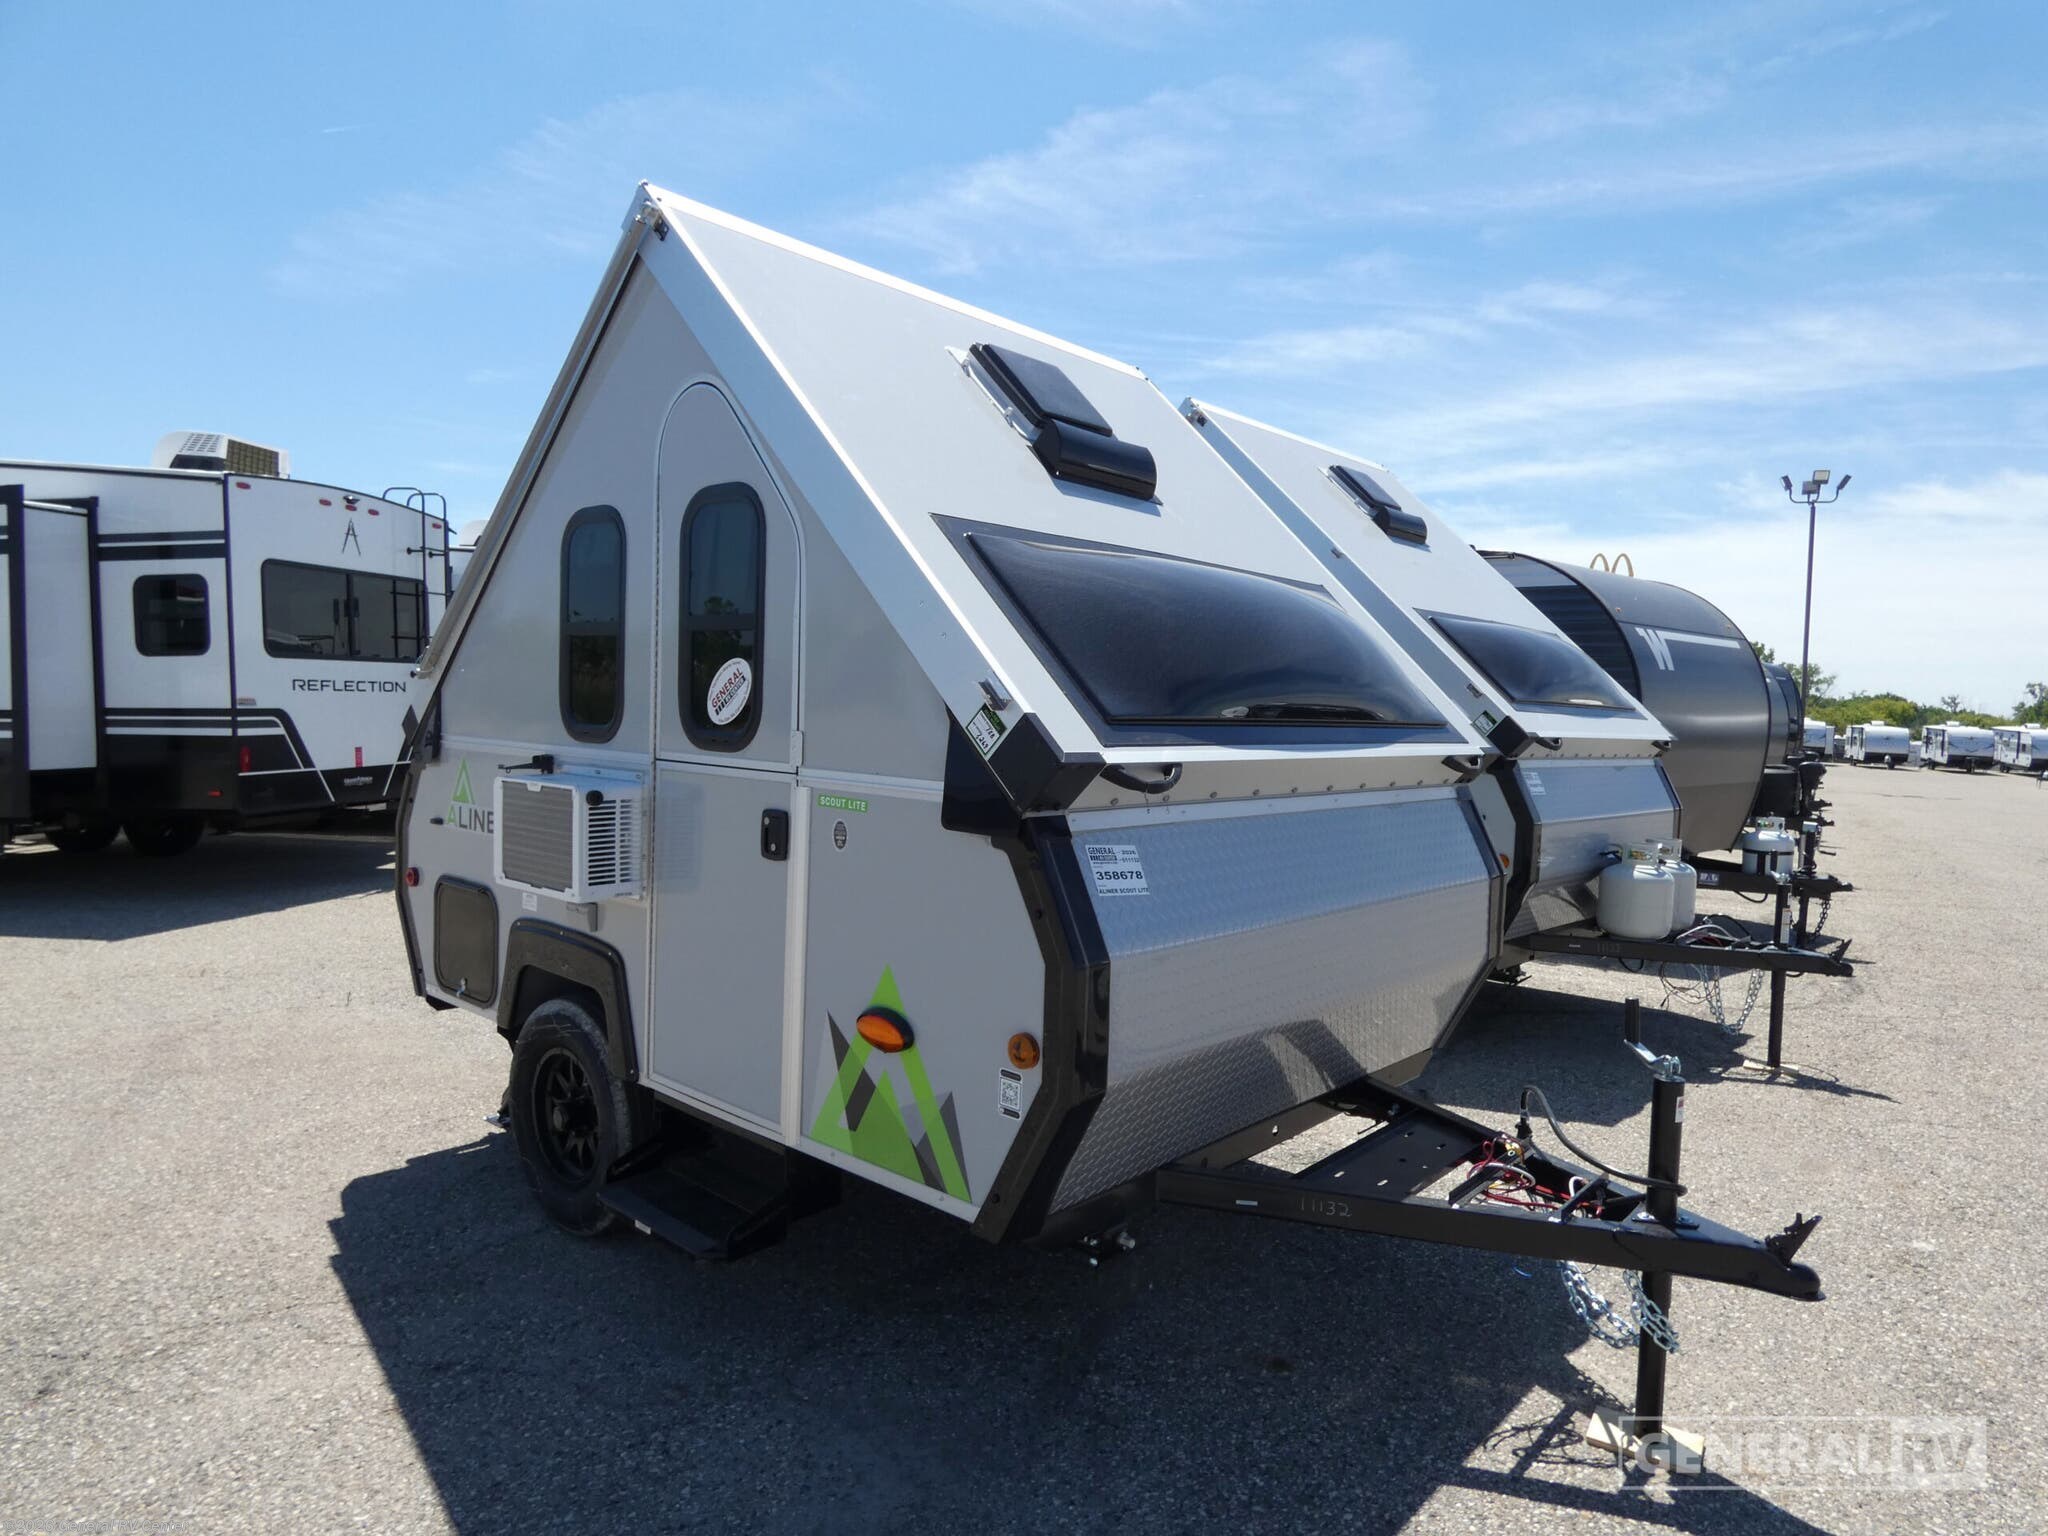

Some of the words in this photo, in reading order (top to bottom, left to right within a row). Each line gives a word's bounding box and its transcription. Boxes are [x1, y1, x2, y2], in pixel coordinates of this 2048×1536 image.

[292, 679, 407, 693] REFLECTION
[711, 667, 743, 708] GENERAL
[820, 796, 846, 808] SCOUT
[848, 800, 866, 811] LITE
[447, 804, 494, 834] ALINE
[1095, 870, 1144, 881] 358678
